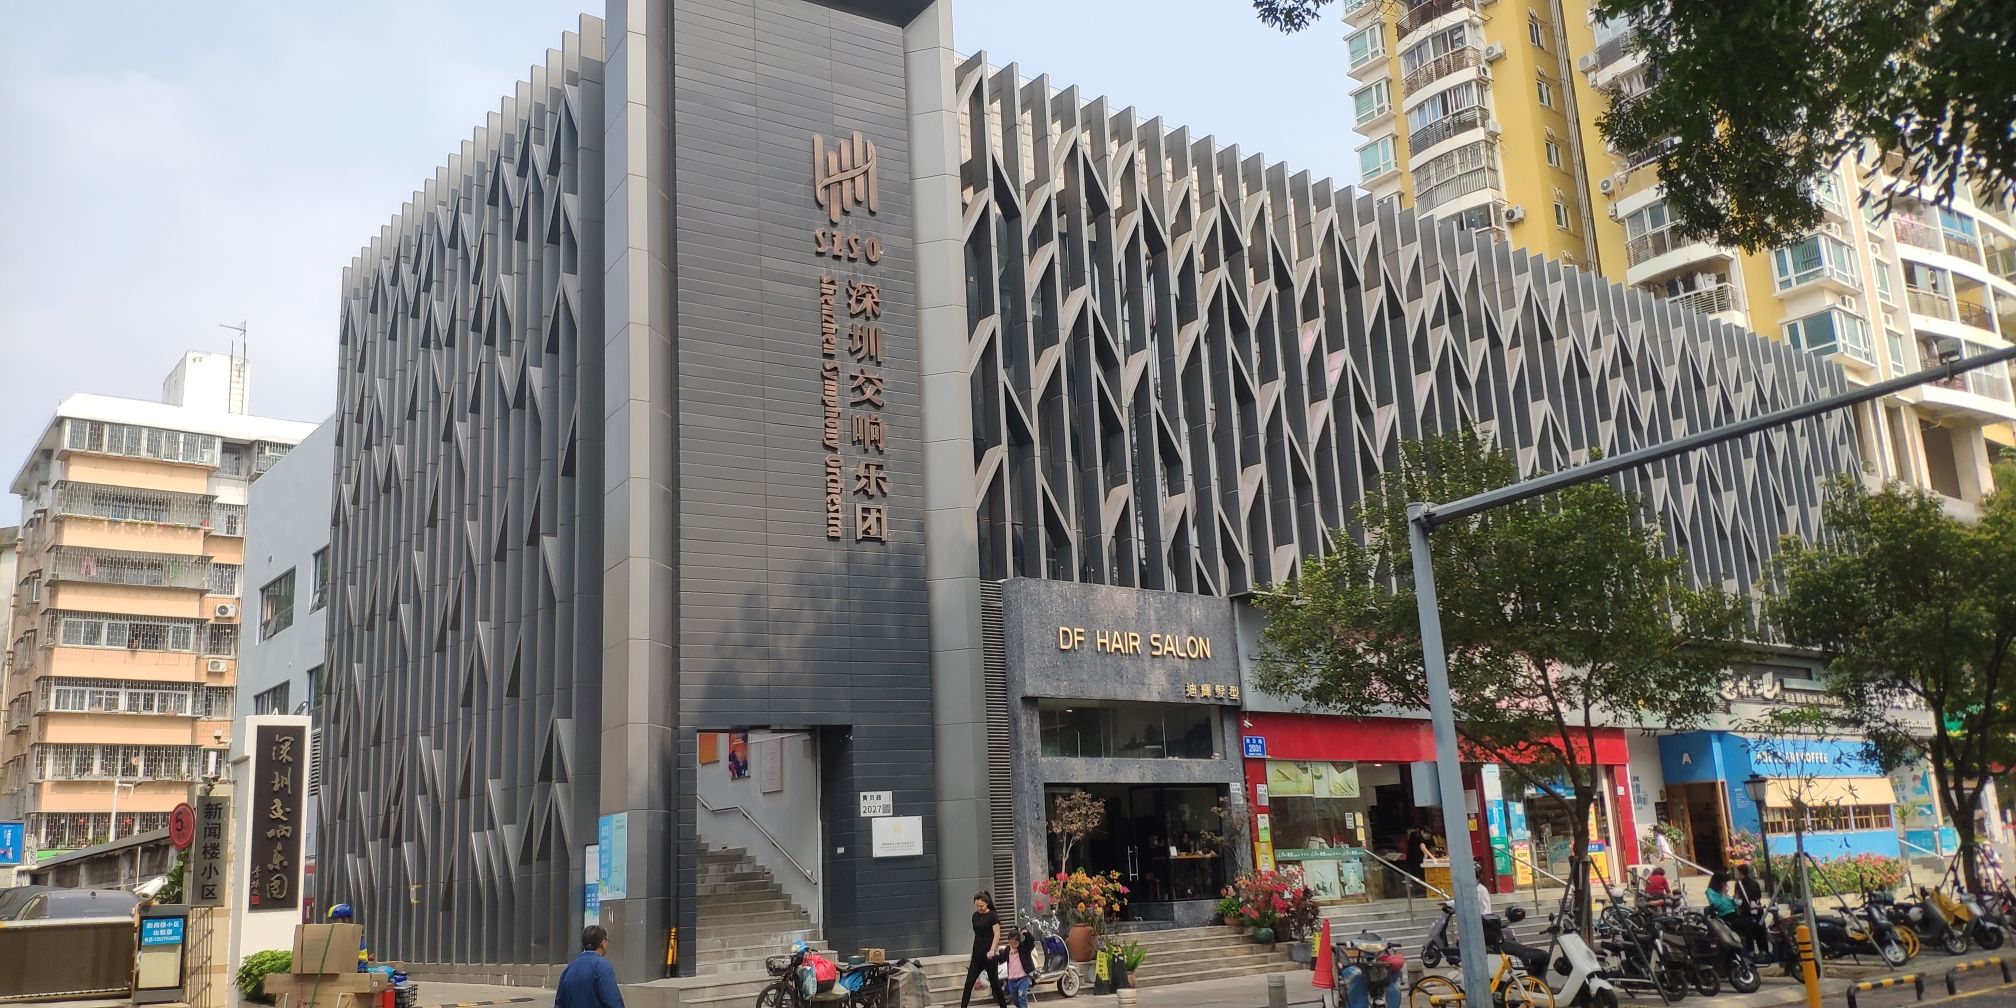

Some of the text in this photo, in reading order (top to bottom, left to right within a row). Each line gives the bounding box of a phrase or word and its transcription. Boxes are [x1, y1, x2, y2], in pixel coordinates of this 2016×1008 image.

[820, 274, 844, 540] Shenzhen Symphony Orchestra
[846, 277, 889, 543] 深圳交响乐团
[1058, 625, 1211, 659] DF HAIR SALON
[1681, 752, 1692, 765] A
[175, 811, 184, 832] 5
[862, 805, 882, 814] 2027
[200, 802, 224, 901] 新闻楼小区
